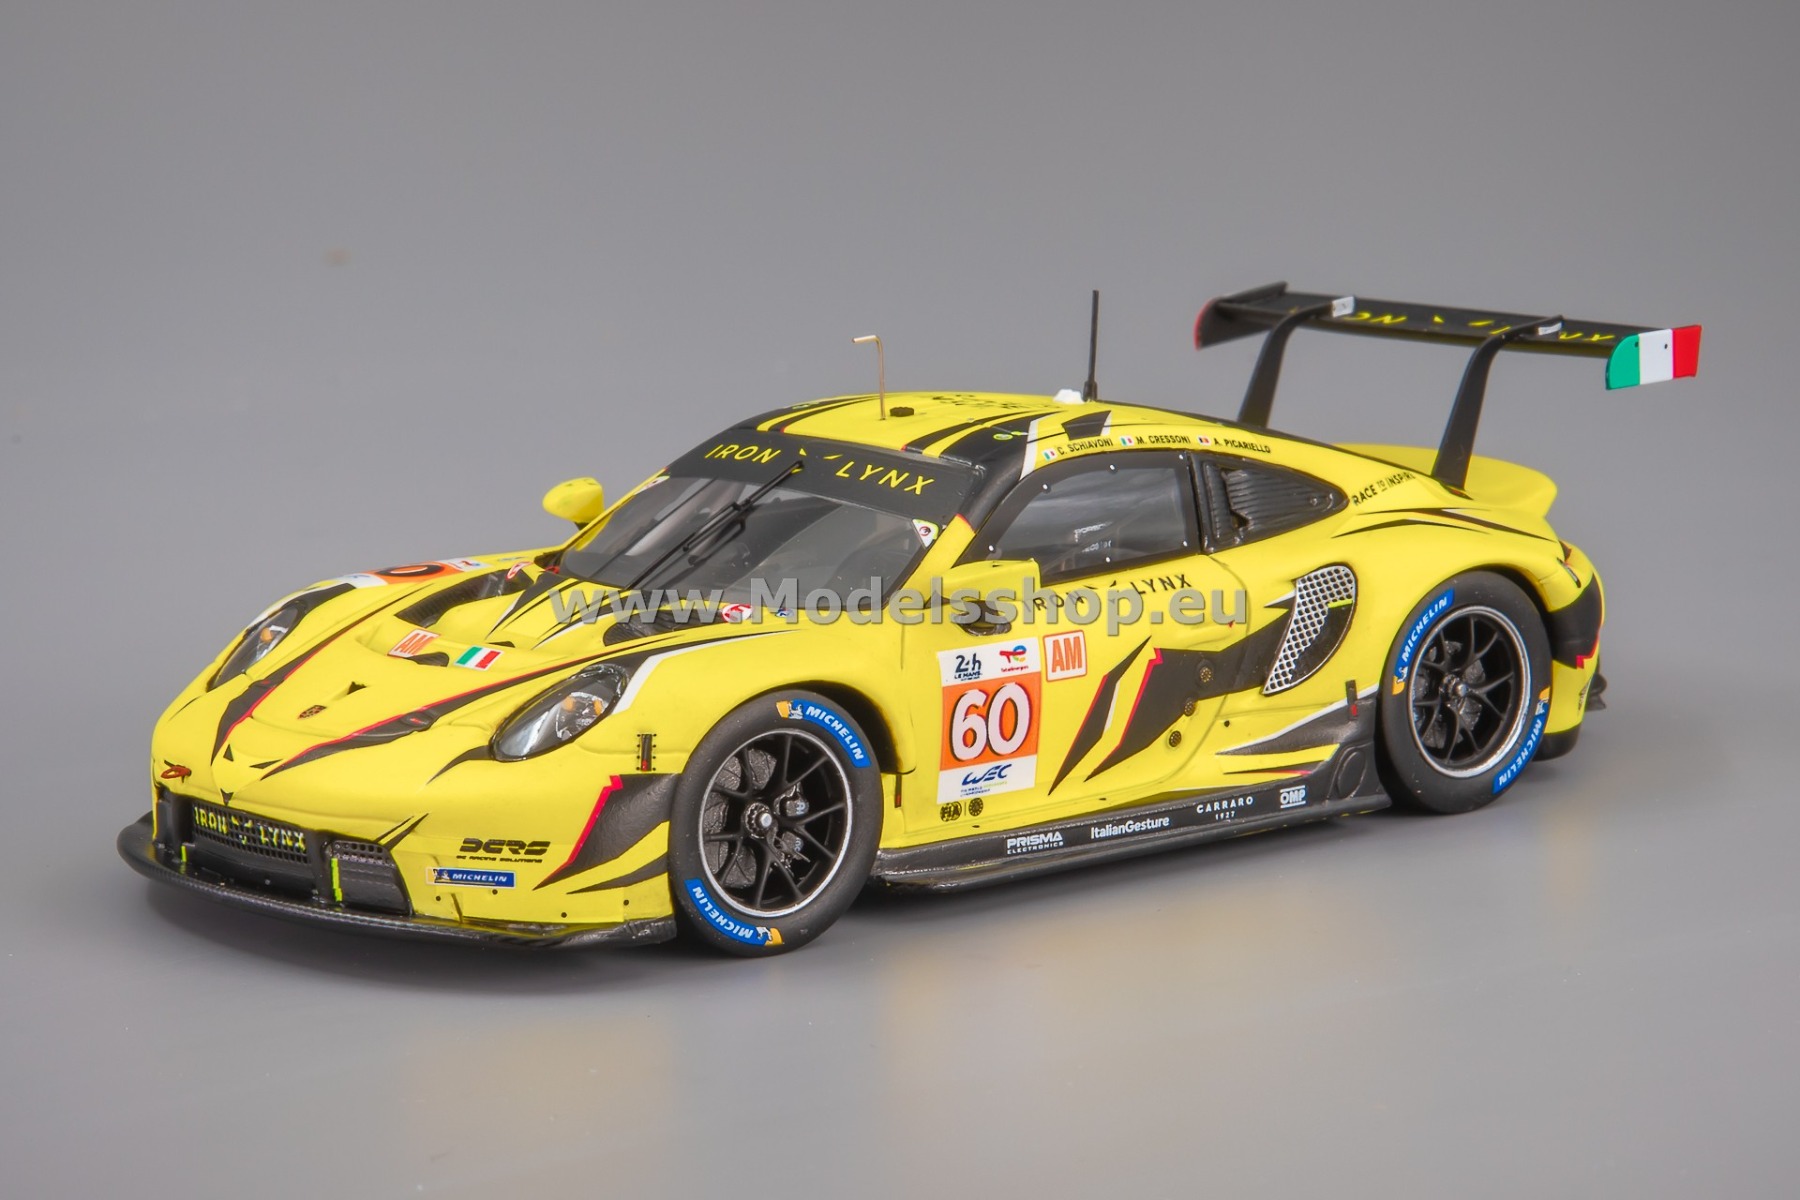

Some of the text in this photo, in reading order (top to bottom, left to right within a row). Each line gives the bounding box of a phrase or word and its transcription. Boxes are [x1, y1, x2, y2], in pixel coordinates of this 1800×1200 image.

[1067, 438, 1113, 453] SCHIAVONI
[1136, 435, 1191, 445] M. CRESSONI
[1224, 439, 1271, 454] PICARIELLO
[704, 444, 935, 496] IRON LYNX
[1352, 484, 1378, 506] RACE
[1130, 574, 1192, 596] LYNX
[1402, 596, 1448, 662] MICHELIN
[1051, 636, 1083, 673] AM
[805, 705, 864, 761] MICHELIN
[949, 682, 1033, 762] 60
[1499, 719, 1542, 785] MICHELIN
[961, 763, 1012, 786] WEC
[1196, 796, 1253, 814] CARRARO
[1280, 788, 1306, 805] OMP
[194, 806, 306, 851] IRON LYNX
[1090, 816, 1170, 839] ItalianGesture
[1007, 831, 1063, 849] PRISMA
[1007, 841, 1064, 855] ELECTRONICS
[452, 873, 508, 882] MICHELIN
[692, 886, 753, 939] MICHELIN
